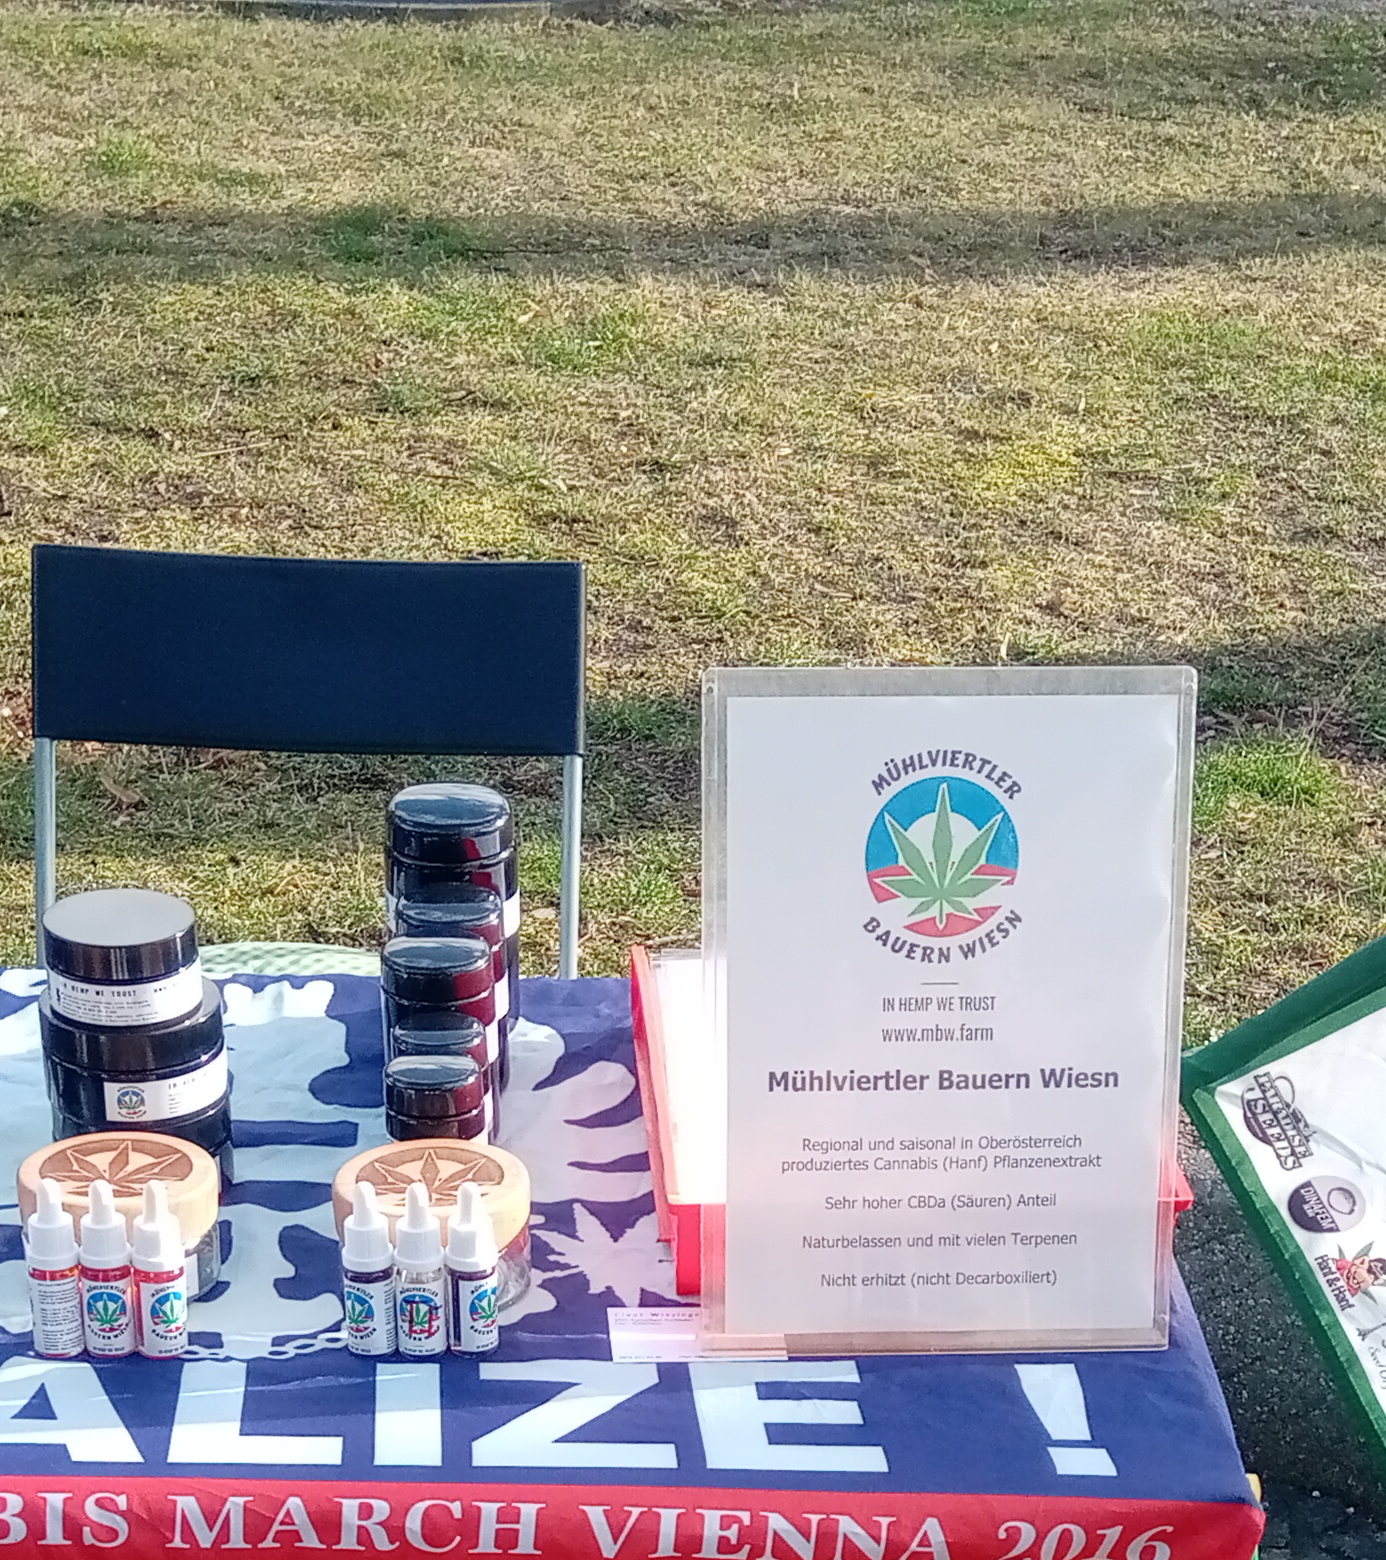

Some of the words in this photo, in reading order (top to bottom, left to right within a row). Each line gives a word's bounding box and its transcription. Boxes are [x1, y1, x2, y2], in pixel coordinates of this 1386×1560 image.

[871, 748, 1022, 800] MÜHLVIERTLER
[863, 916, 952, 965] BAUERN
[959, 909, 1024, 960] WIESN
[883, 997, 894, 1012] IN
[899, 997, 932, 1012] HEMP
[937, 997, 955, 1011] WE
[958, 996, 996, 1011] TRUST
[882, 1024, 993, 1042] www.mbw.farm
[769, 1070, 929, 1092] Mühlviertler
[939, 1070, 1030, 1090] Bauern
[1040, 1067, 1118, 1088] Wiesn
[1253, 1071, 1314, 1160] PARADISE
[803, 1138, 862, 1154] Regional
[869, 1137, 894, 1151] und
[900, 1137, 955, 1150] saisonal
[961, 1137, 973, 1149] in
[979, 1134, 1082, 1149] Oberösterreich
[1248, 1097, 1303, 1171] SEEDS
[782, 1158, 869, 1174] produziertes
[874, 1156, 938, 1170] Cannabis
[943, 1155, 988, 1172] (Hanf)
[994, 1154, 1102, 1168] Pflanzenextrakt
[825, 1196, 857, 1210] Sehr
[863, 1196, 903, 1209] hoher
[908, 1196, 945, 1208] CBDa
[951, 1194, 1012, 1211] (Säuren)
[1017, 1194, 1056, 1206] Anteil
[1299, 1186, 1334, 1230] DINAFEM
[803, 1235, 901, 1248] Naturbelassen
[907, 1234, 933, 1247] und
[939, 1234, 961, 1246] mit
[965, 1233, 1006, 1246] vielen
[1011, 1233, 1077, 1248] Terpenen
[821, 1274, 857, 1286] Nicht
[862, 1273, 906, 1286] erhitzt
[911, 1272, 951, 1288] (nicht
[956, 1270, 1057, 1286] Decarboxiliert)
[1314, 1254, 1336, 1278] Hanf
[1331, 1285, 1355, 1312] Hanf
[1014, 1363, 1118, 1477] !
[168, 1493, 549, 1556] MARCH
